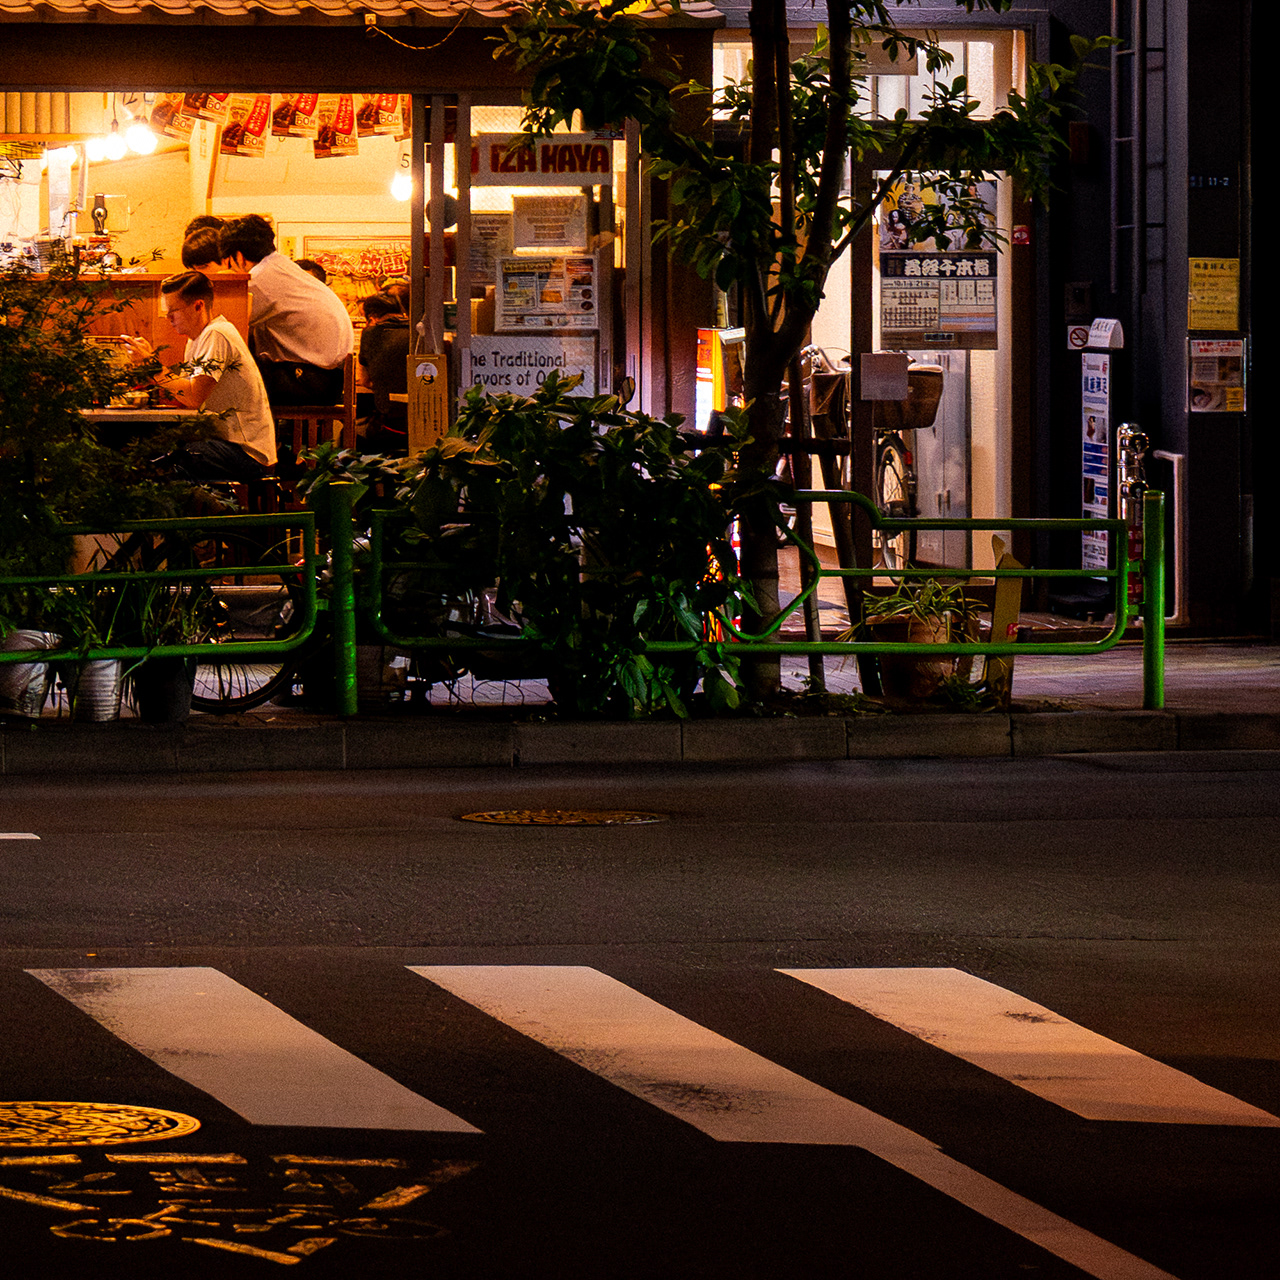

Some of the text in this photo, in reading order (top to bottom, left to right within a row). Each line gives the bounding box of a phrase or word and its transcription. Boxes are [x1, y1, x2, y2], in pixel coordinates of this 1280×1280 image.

[470, 350, 567, 368] he Traditional
[470, 369, 512, 386] lavors
[516, 369, 531, 386] of
